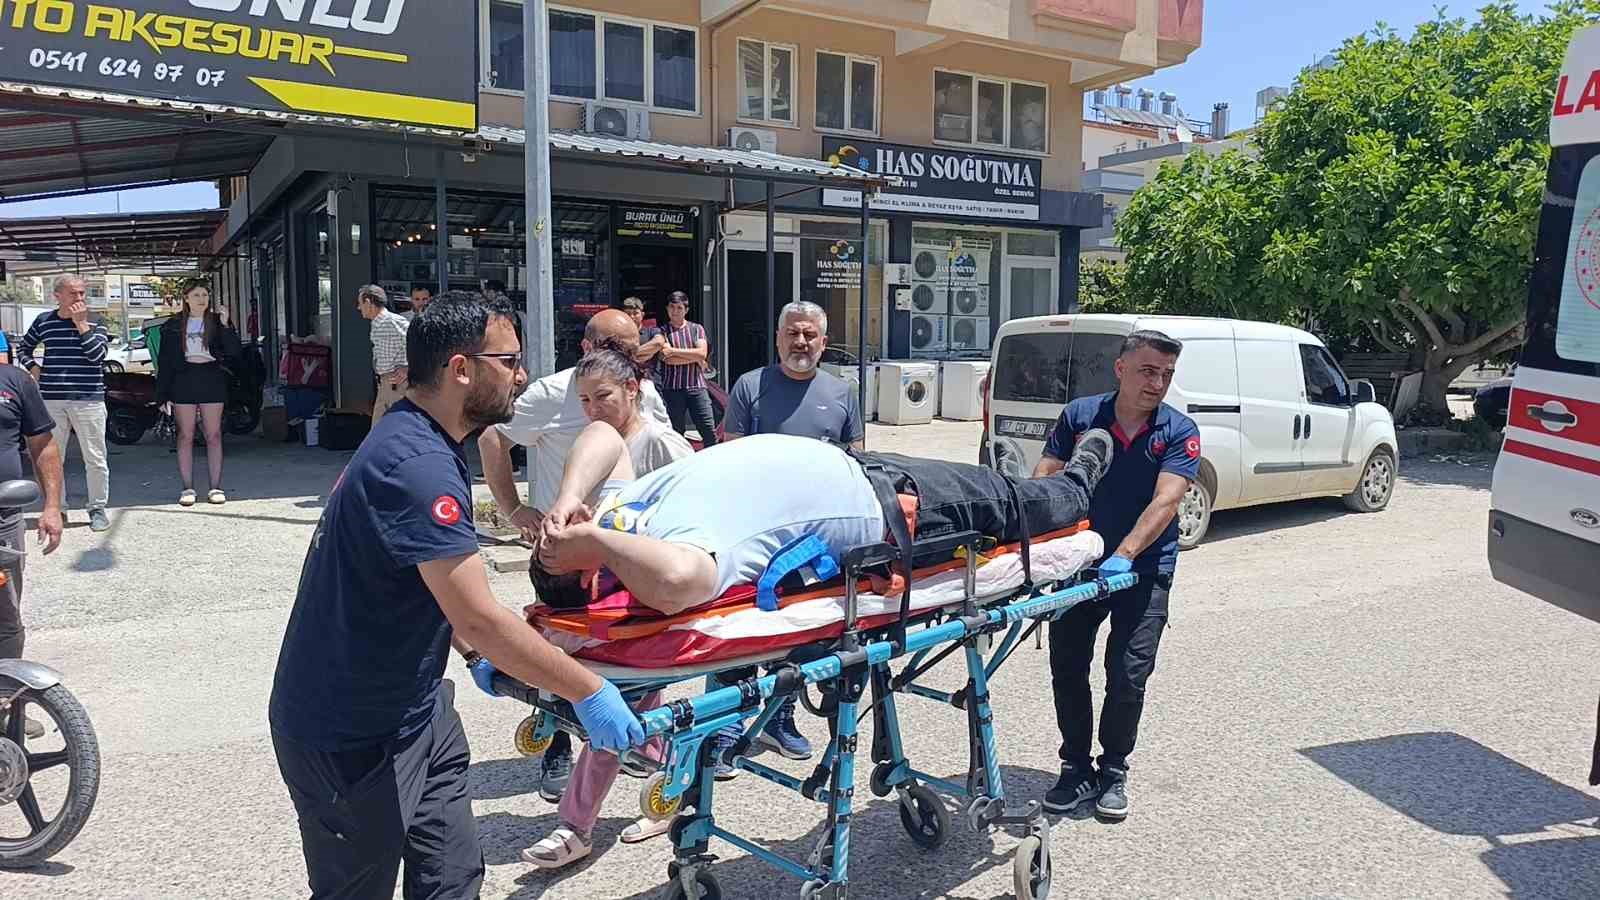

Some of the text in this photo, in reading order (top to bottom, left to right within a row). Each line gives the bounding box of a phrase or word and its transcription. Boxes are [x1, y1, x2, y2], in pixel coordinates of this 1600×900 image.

[84, 4, 336, 77] AKSESUAR
[29, 48, 225, 88] 0541 624 97 07
[876, 149, 1035, 188] HAS SOĞUTMA
[625, 211, 684, 223] BURAK ÜNLÜ
